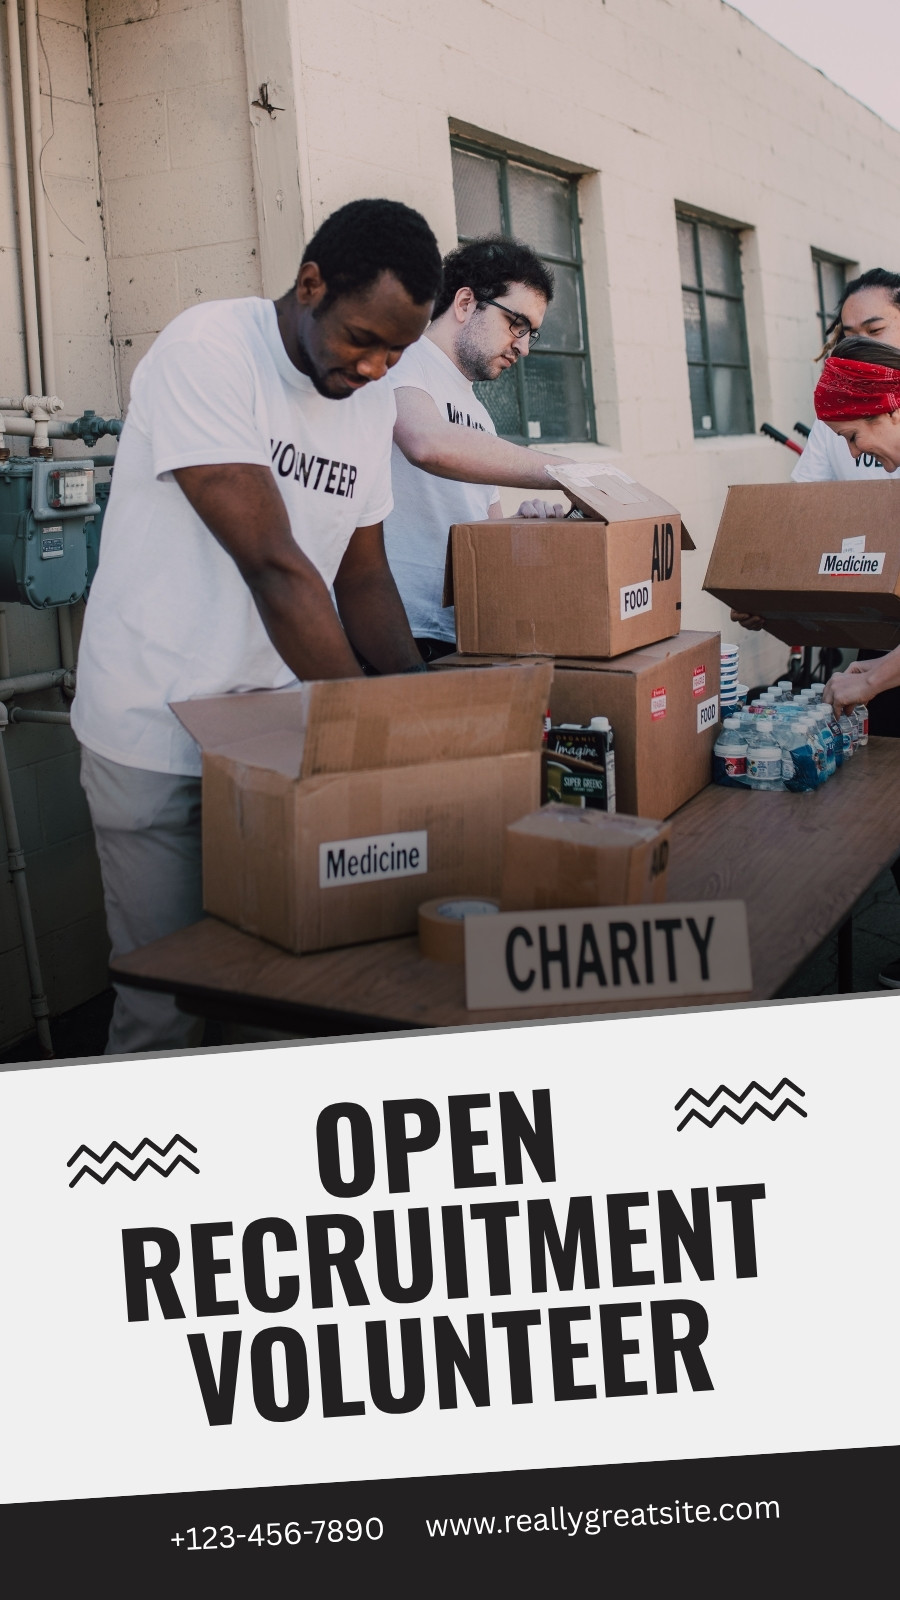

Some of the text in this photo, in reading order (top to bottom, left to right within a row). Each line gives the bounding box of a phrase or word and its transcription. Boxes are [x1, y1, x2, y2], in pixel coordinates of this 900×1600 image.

[652, 522, 675, 584] AID
[823, 554, 879, 573] Medicine
[624, 586, 649, 612] FOOD
[700, 703, 716, 725] FOOD
[563, 776, 582, 788] SUPER
[582, 777, 603, 790] GREENS
[326, 841, 421, 880] Medicine
[504, 915, 716, 993] CHARITY
